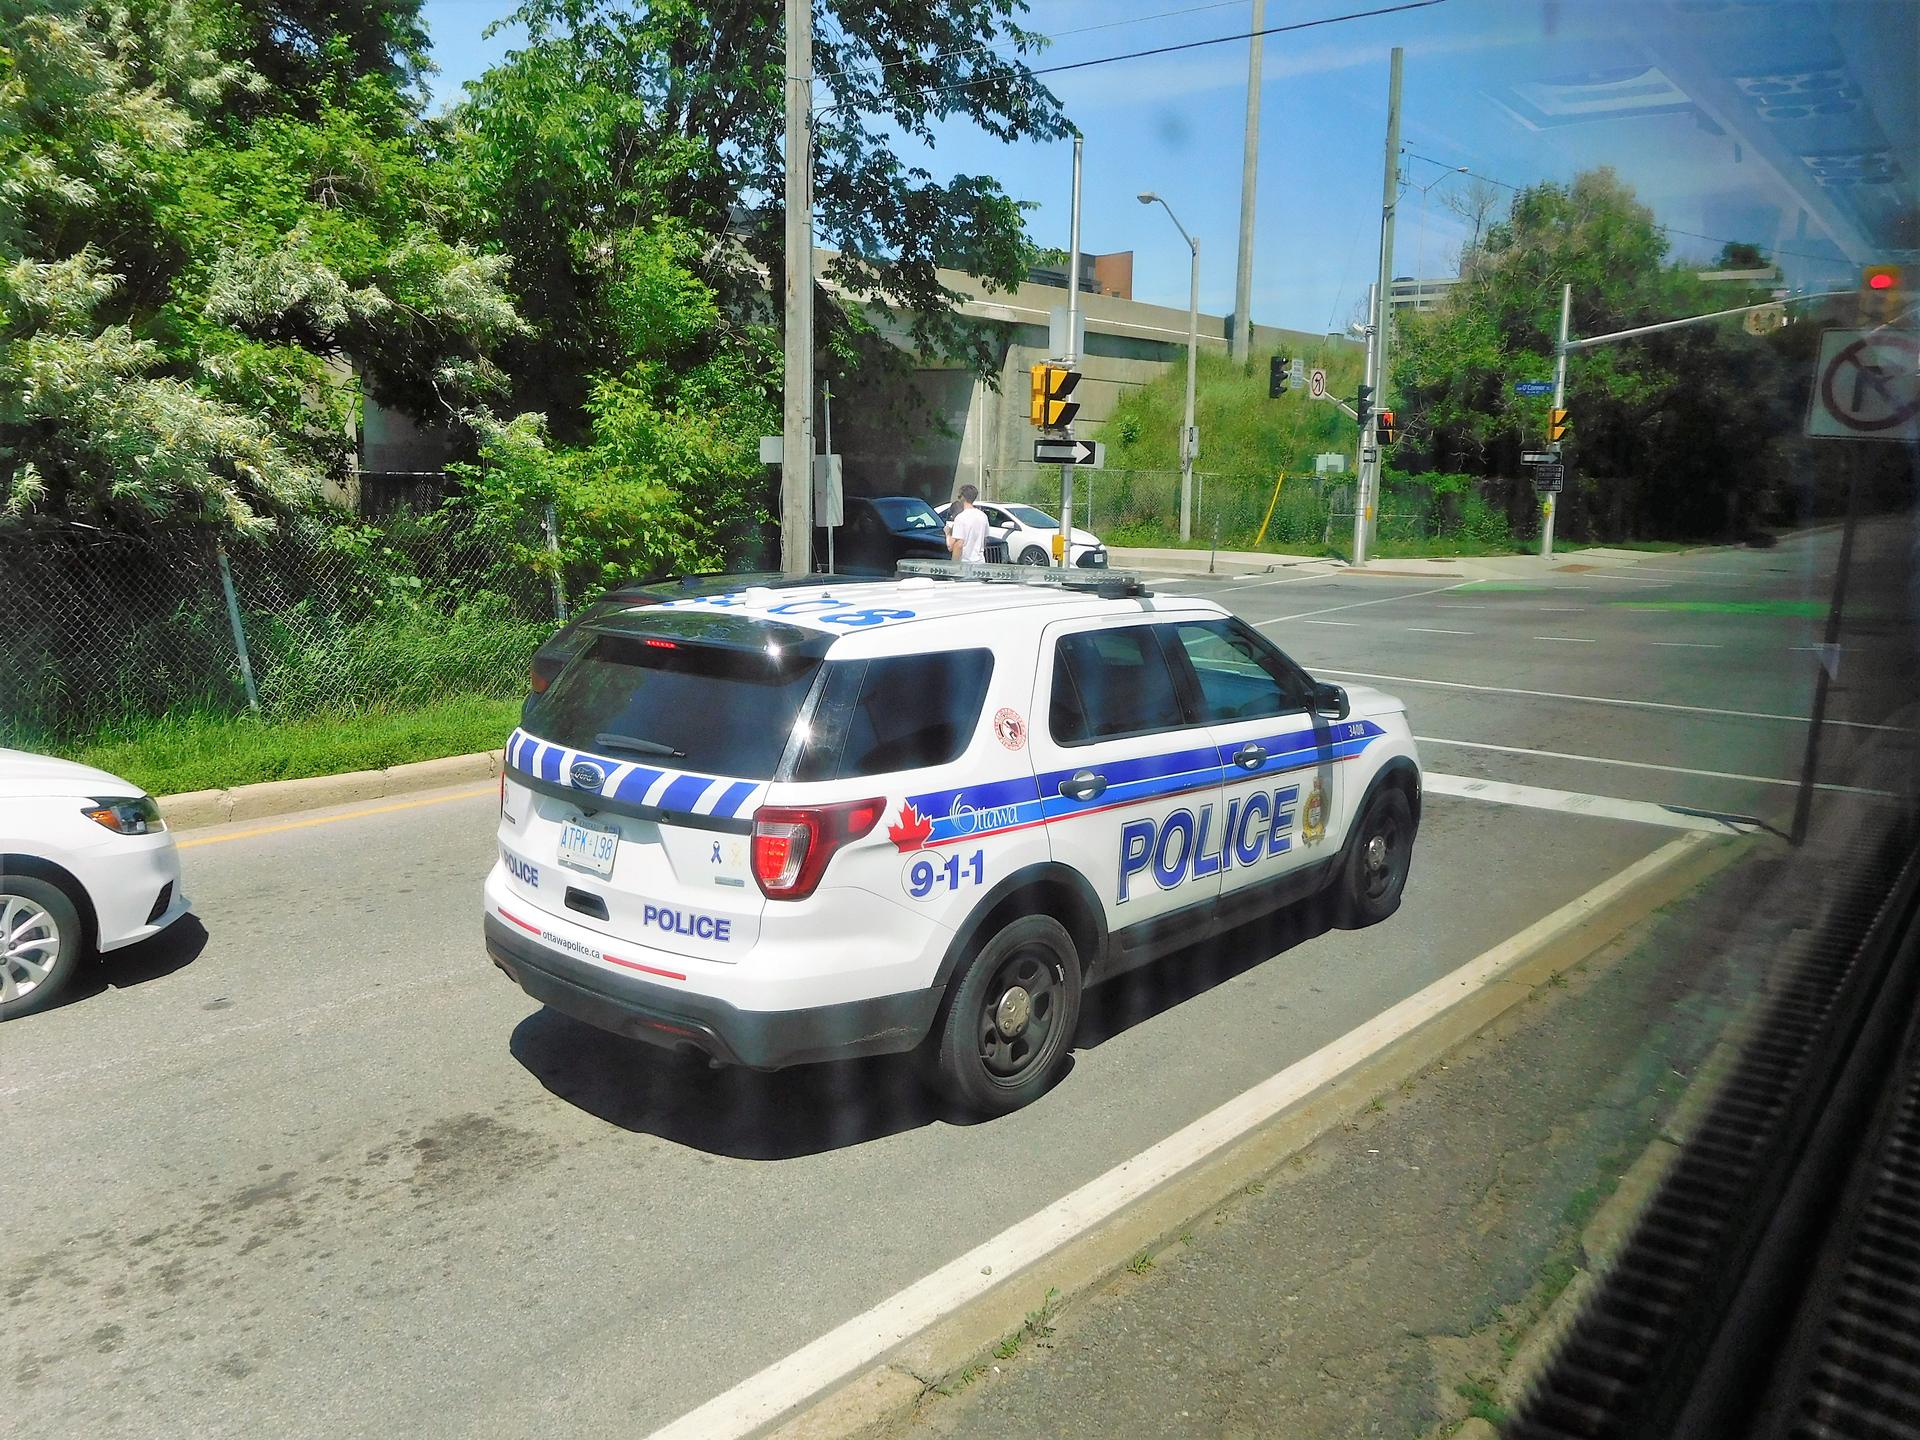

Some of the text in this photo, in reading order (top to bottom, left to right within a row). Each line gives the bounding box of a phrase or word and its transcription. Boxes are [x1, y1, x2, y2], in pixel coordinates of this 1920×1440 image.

[574, 766, 596, 782] Ford
[949, 793, 1019, 833] Ottawa
[1116, 783, 1300, 906] POLICE
[503, 848, 539, 888] POLICE
[910, 849, 984, 898] 9-1-1
[643, 904, 732, 942] POLICE
[542, 929, 601, 960] ottawapolice.ca
